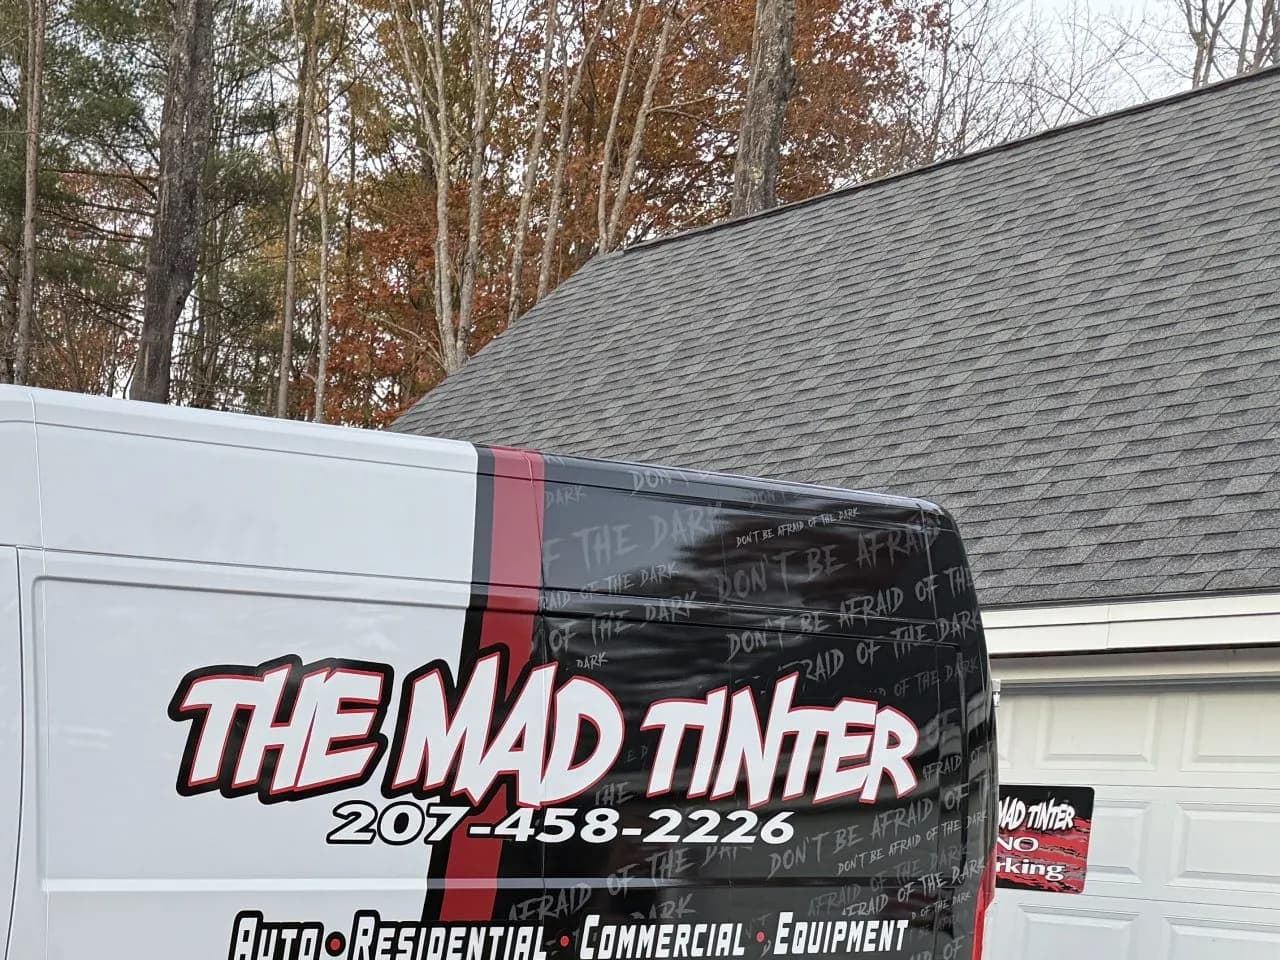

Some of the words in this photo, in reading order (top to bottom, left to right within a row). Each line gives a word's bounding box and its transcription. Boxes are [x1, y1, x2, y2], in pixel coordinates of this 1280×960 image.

[572, 522, 641, 575] THE
[735, 530, 761, 549] DON'T
[761, 528, 775, 541] BE
[777, 519, 805, 537] AFRAID
[838, 506, 860, 521] DARK
[639, 560, 681, 588] DARK
[804, 543, 849, 582] BE
[725, 615, 796, 663] DON'T
[838, 586, 904, 632] AFRAID
[914, 573, 940, 603] OF
[576, 651, 609, 671] DARK
[855, 639, 883, 671] OF
[888, 623, 935, 662] THE
[167, 654, 394, 803] THE
[385, 647, 630, 810] MAD
[639, 671, 920, 807] TINTER
[326, 802, 796, 846] 207-458-2226
[767, 832, 831, 881] DON'T
[832, 824, 865, 854] BE
[870, 798, 934, 841] AFRAID
[943, 782, 970, 811] OF
[1027, 798, 1075, 832] TINTER
[644, 847, 696, 880] THE
[833, 852, 867, 877] DON'T
[868, 847, 886, 865] BE
[888, 834, 922, 856] AFRAID
[925, 824, 940, 841] OF
[940, 819, 962, 837] THE
[896, 881, 917, 903] OF
[917, 871, 946, 897] THE
[943, 936, 966, 960] OF
